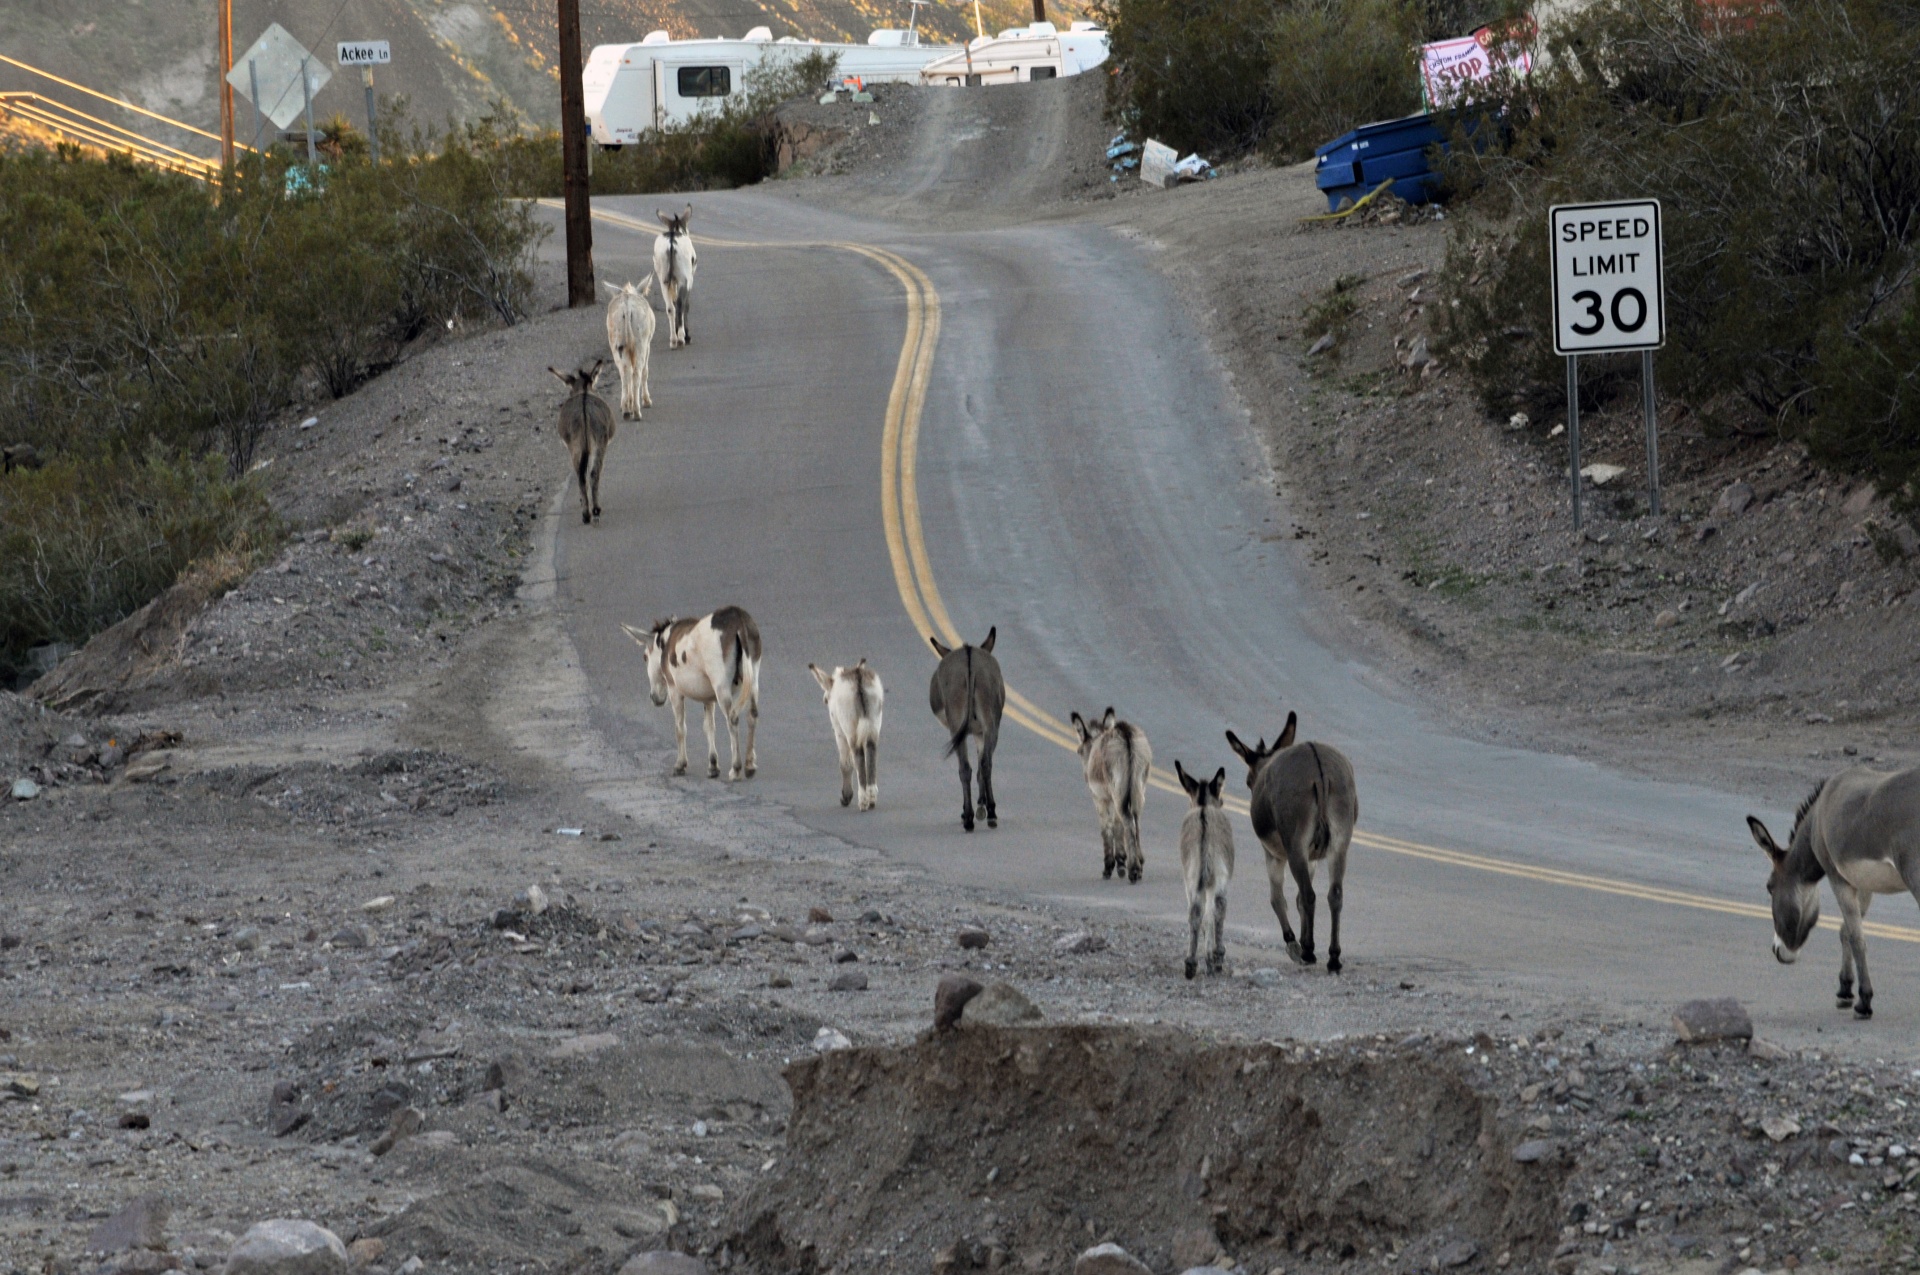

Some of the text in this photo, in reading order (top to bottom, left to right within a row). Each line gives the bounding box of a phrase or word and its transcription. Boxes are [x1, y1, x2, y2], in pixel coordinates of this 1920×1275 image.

[341, 46, 389, 61] Ackee Ln
[1438, 57, 1482, 84] STOP
[1562, 218, 1650, 243] SPEED
[1572, 252, 1640, 277] LIMIT
[1570, 287, 1648, 337] 30
